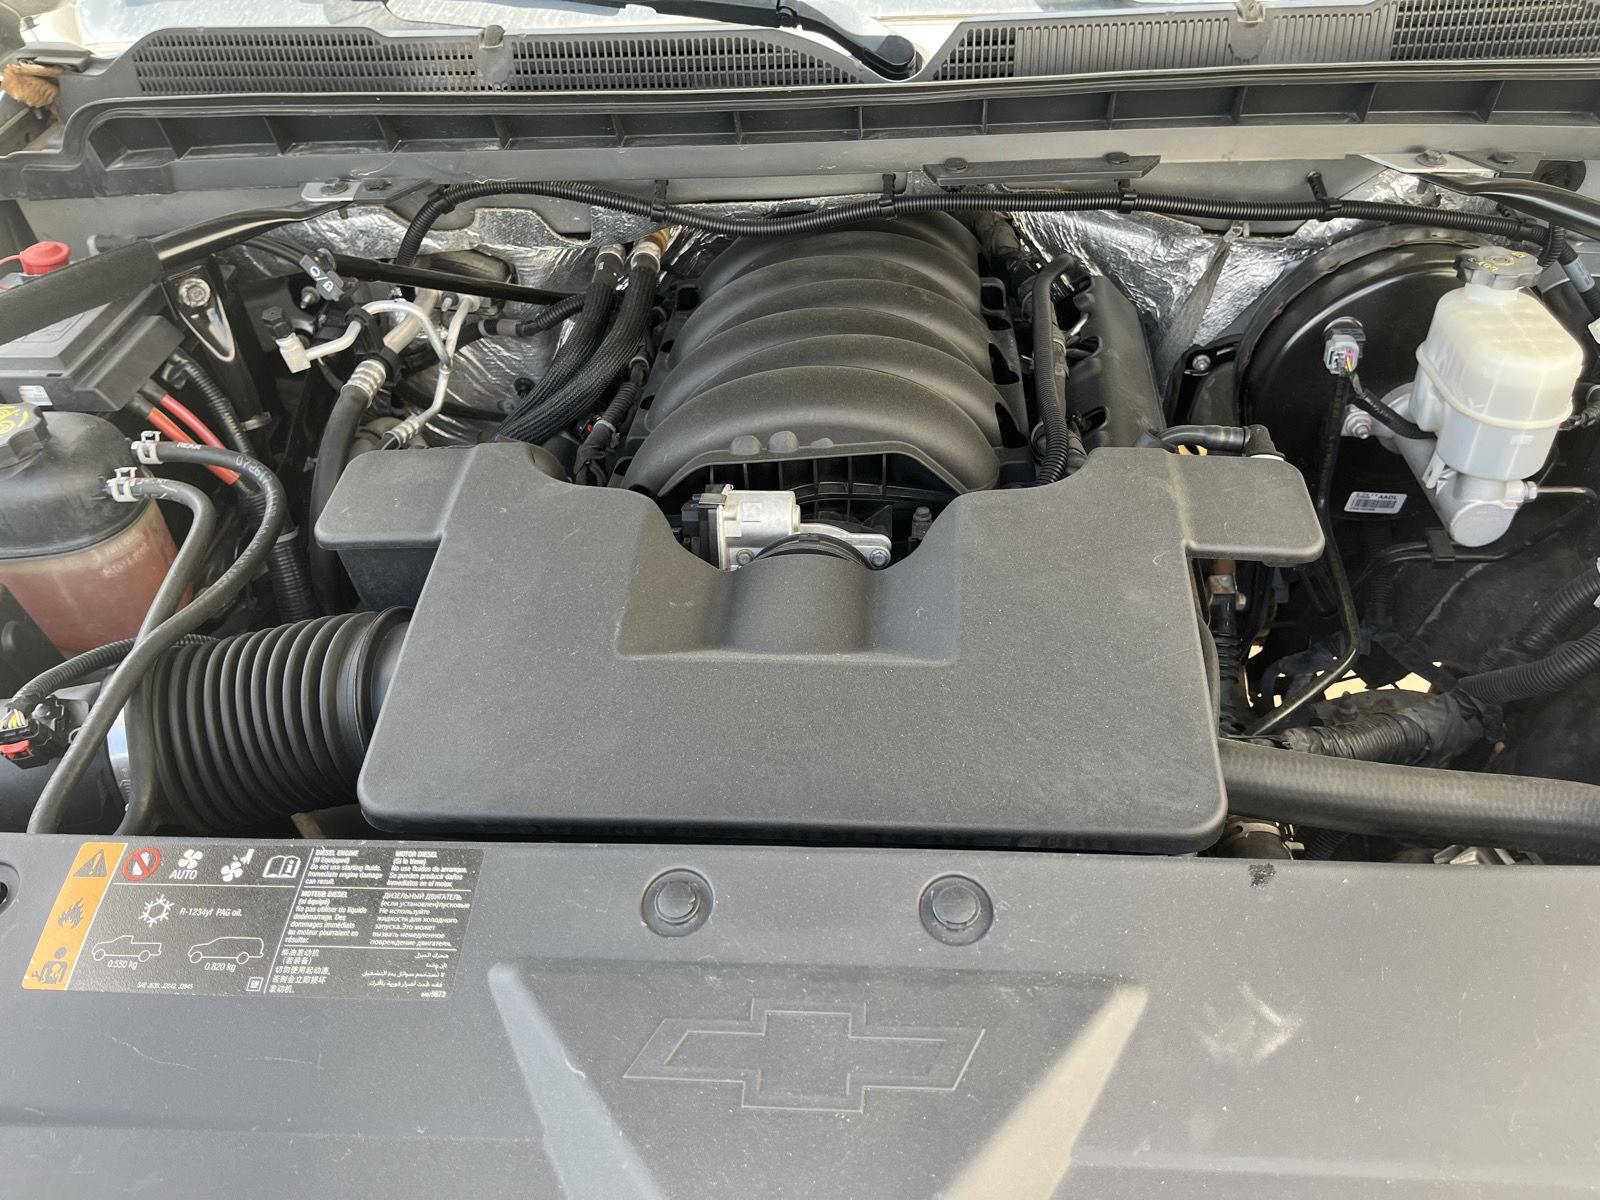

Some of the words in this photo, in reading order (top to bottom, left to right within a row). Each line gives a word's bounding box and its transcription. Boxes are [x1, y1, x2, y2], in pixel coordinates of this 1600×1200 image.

[395, 850, 417, 858] MOTOR
[410, 858, 426, 866] tiene)
[341, 864, 364, 872] starting
[169, 870, 198, 880] AUTO
[359, 872, 383, 880] damage
[398, 872, 420, 880] pueden
[300, 890, 326, 898] MOTEUR
[382, 892, 425, 900] ДИЗЕЛЬНЫЙ
[180, 907, 214, 918] R-1234yf
[216, 908, 232, 916] PAG
[346, 906, 368, 914] liquide
[389, 908, 430, 916] используйте
[290, 920, 324, 928] dommages
[108, 960, 128, 968] 0.550
[128, 961, 138, 970] kg
[204, 962, 226, 970] 0.820
[226, 962, 236, 972] kg
